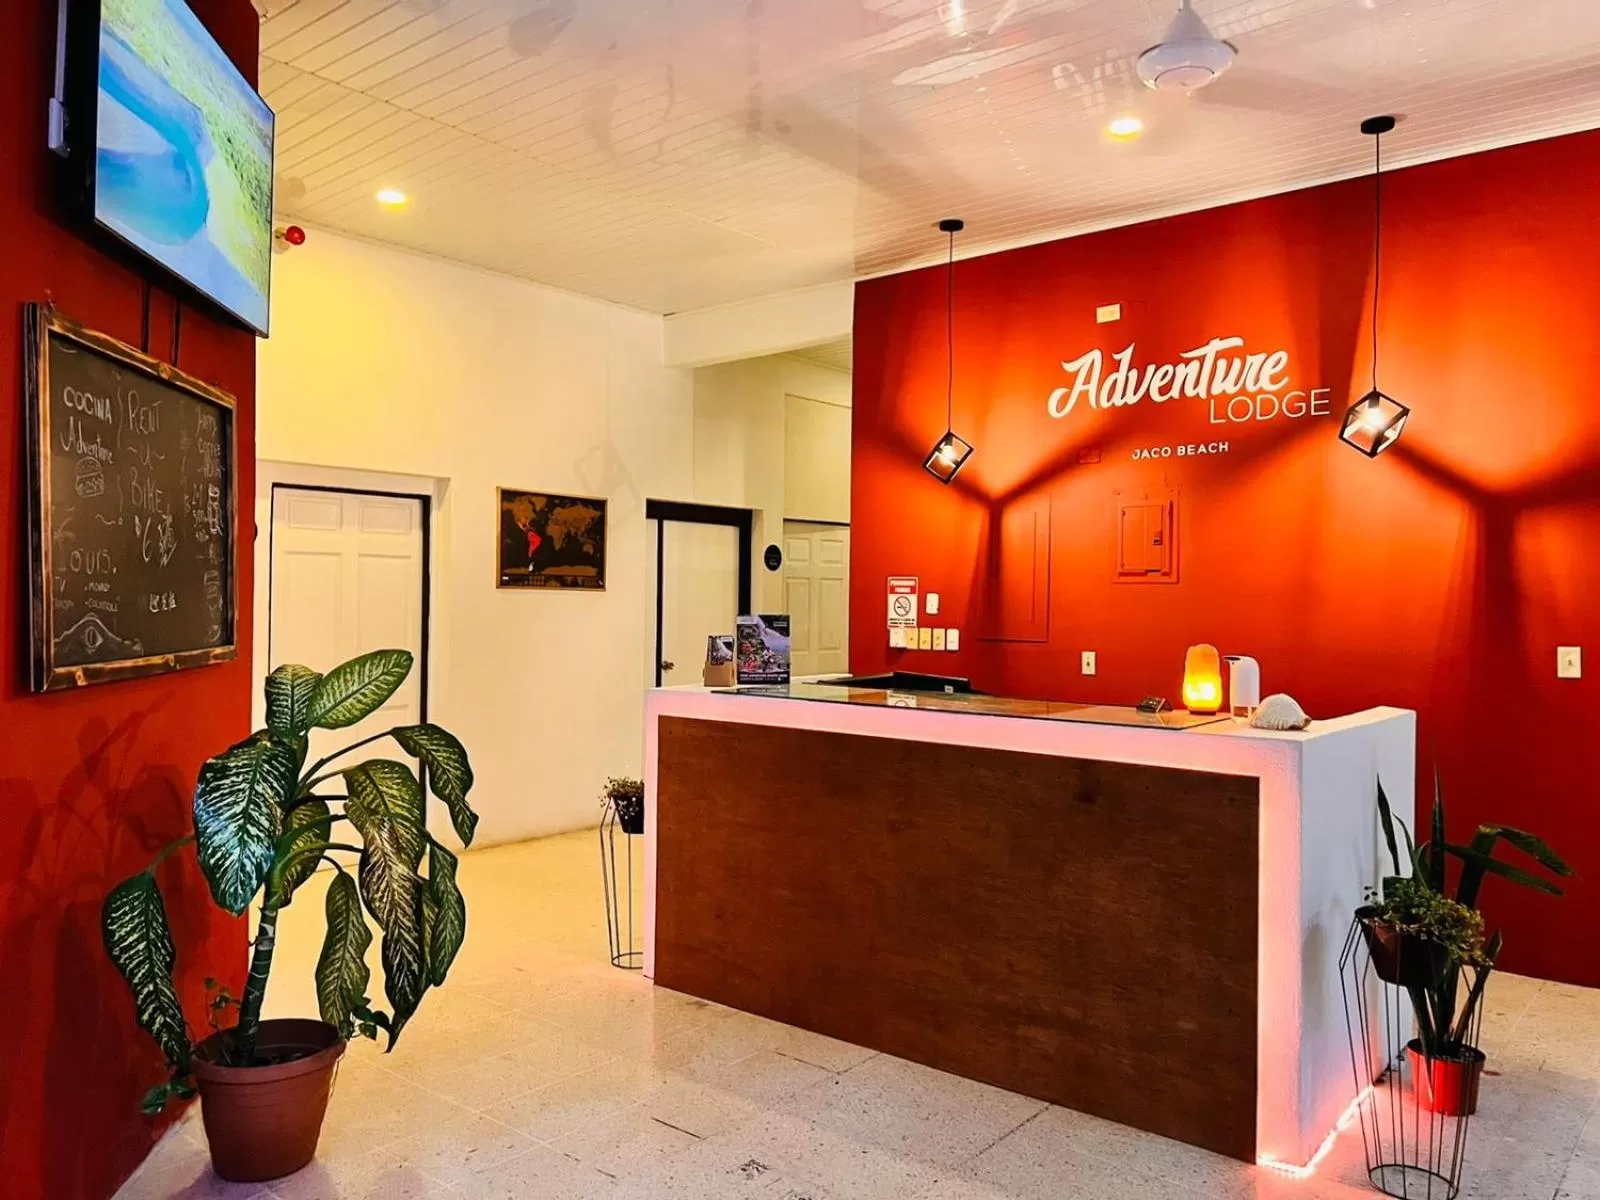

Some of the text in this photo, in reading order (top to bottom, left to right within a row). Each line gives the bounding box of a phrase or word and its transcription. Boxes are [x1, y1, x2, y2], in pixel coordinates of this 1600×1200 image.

[1048, 337, 1289, 418] Adventure
[63, 386, 112, 424] COCINA
[127, 390, 163, 434] RENT
[1209, 387, 1331, 424] LODGE
[1132, 442, 1229, 460] JACO BEACH
